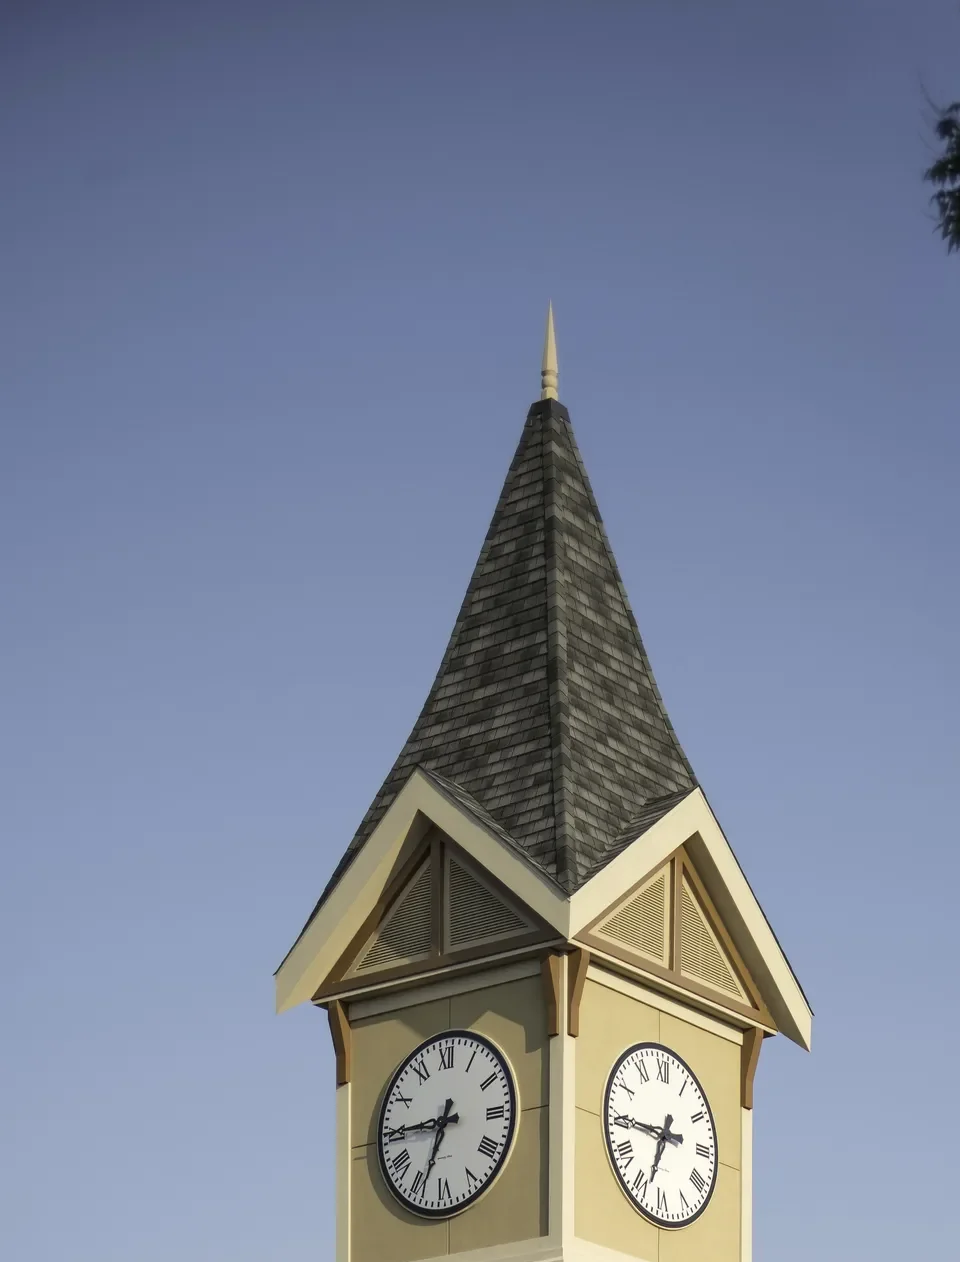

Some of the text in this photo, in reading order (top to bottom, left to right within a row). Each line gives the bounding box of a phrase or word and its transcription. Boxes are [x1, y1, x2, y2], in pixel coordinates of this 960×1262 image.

[438, 1046, 454, 1071] XII
[465, 1051, 477, 1072] I
[413, 1059, 431, 1086] XI
[480, 1072, 498, 1091] II
[634, 1058, 650, 1085] XI
[656, 1058, 669, 1084] XII
[394, 1091, 413, 1109] X
[619, 1077, 635, 1101] X
[678, 1079, 688, 1097] I
[486, 1105, 505, 1121] III
[690, 1111, 704, 1123] II
[477, 1135, 499, 1159] IIII
[617, 1140, 635, 1169] VIII
[695, 1142, 710, 1159] III
[392, 1148, 412, 1181] VIII
[410, 1170, 427, 1198] VII
[438, 1177, 452, 1200] VI
[465, 1167, 478, 1188] V
[632, 1169, 648, 1199] VII
[689, 1167, 706, 1193] IIII
[657, 1186, 668, 1212] VI
[679, 1188, 690, 1212] V
